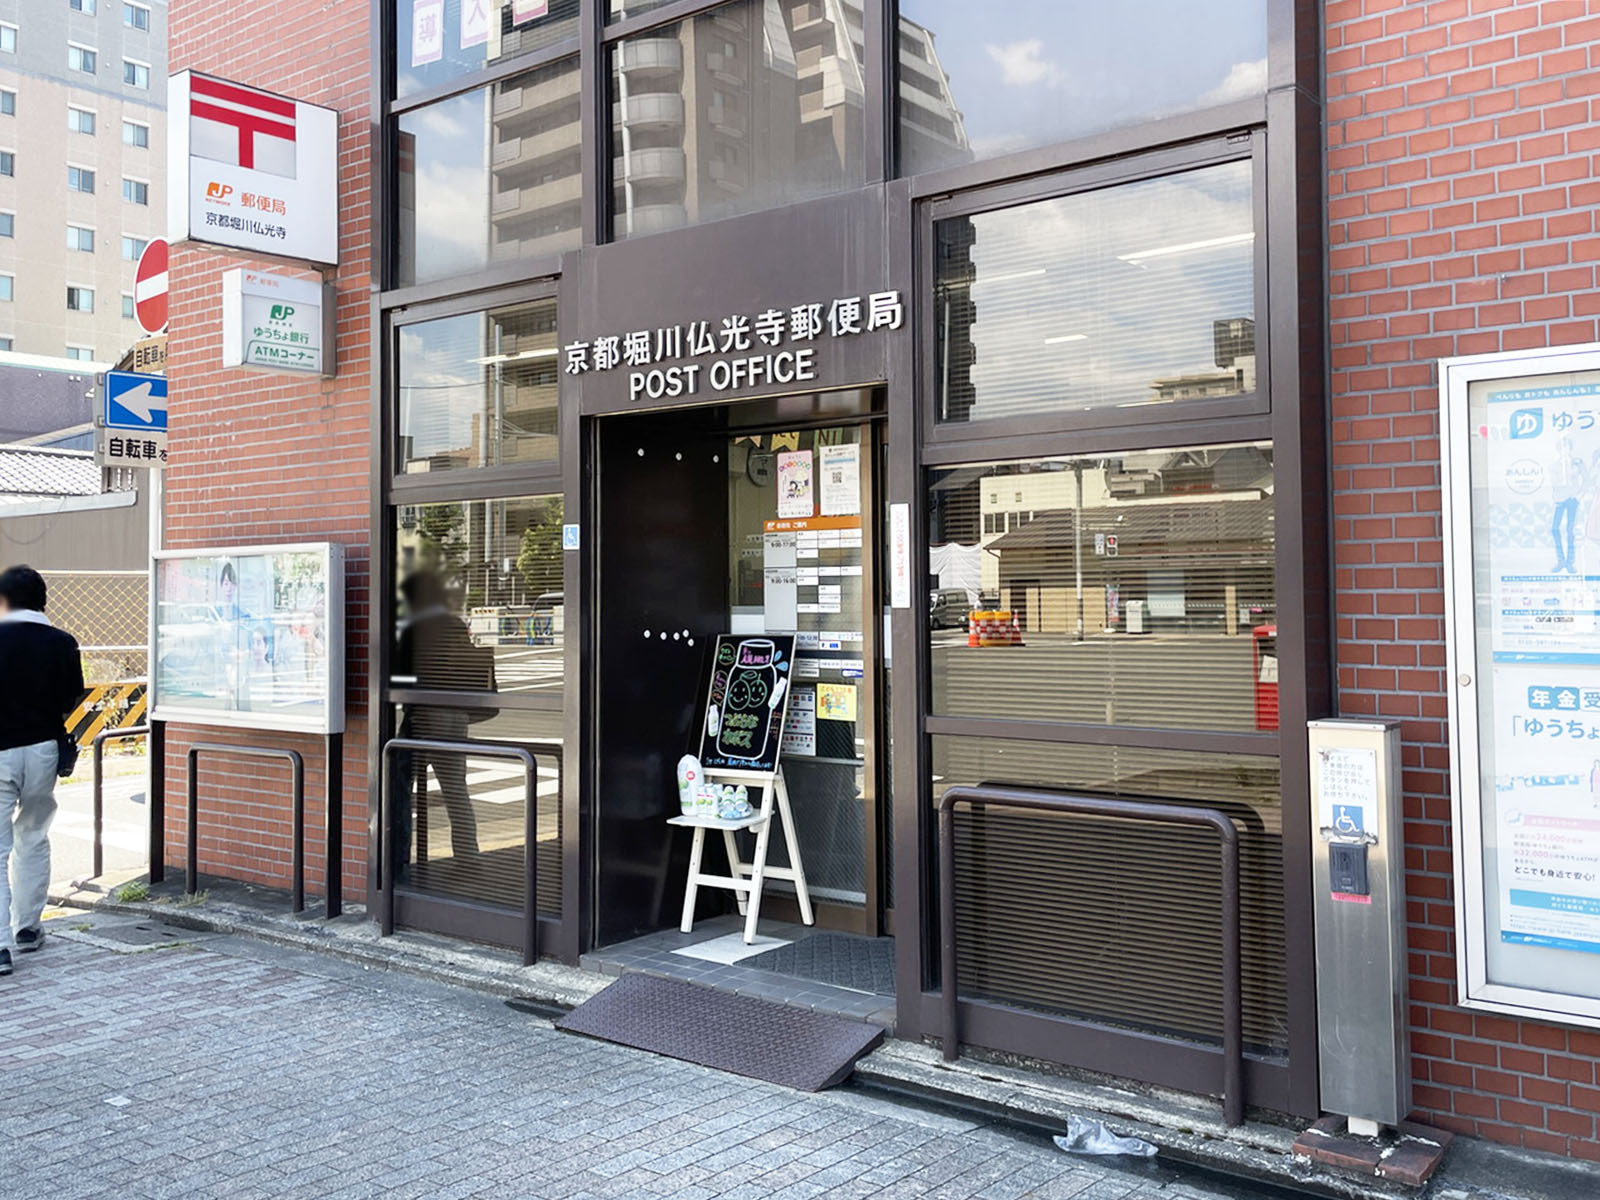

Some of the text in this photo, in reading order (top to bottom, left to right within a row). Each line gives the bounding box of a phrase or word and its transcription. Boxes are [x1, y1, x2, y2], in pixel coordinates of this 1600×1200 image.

[241, 192, 287, 216] 郵便局
[205, 211, 287, 240] 京都堀川仏光寺
[253, 327, 310, 345] ゆうちょ銀行
[564, 289, 905, 376] 京都堀川仏光寺郵便局
[136, 343, 168, 368] 自転車を
[255, 346, 315, 361] ATMコーナー
[630, 348, 815, 401] POST OFFICE
[1552, 410, 1600, 433] ゆう
[1514, 865, 1596, 882] どこでも身近で安心!
